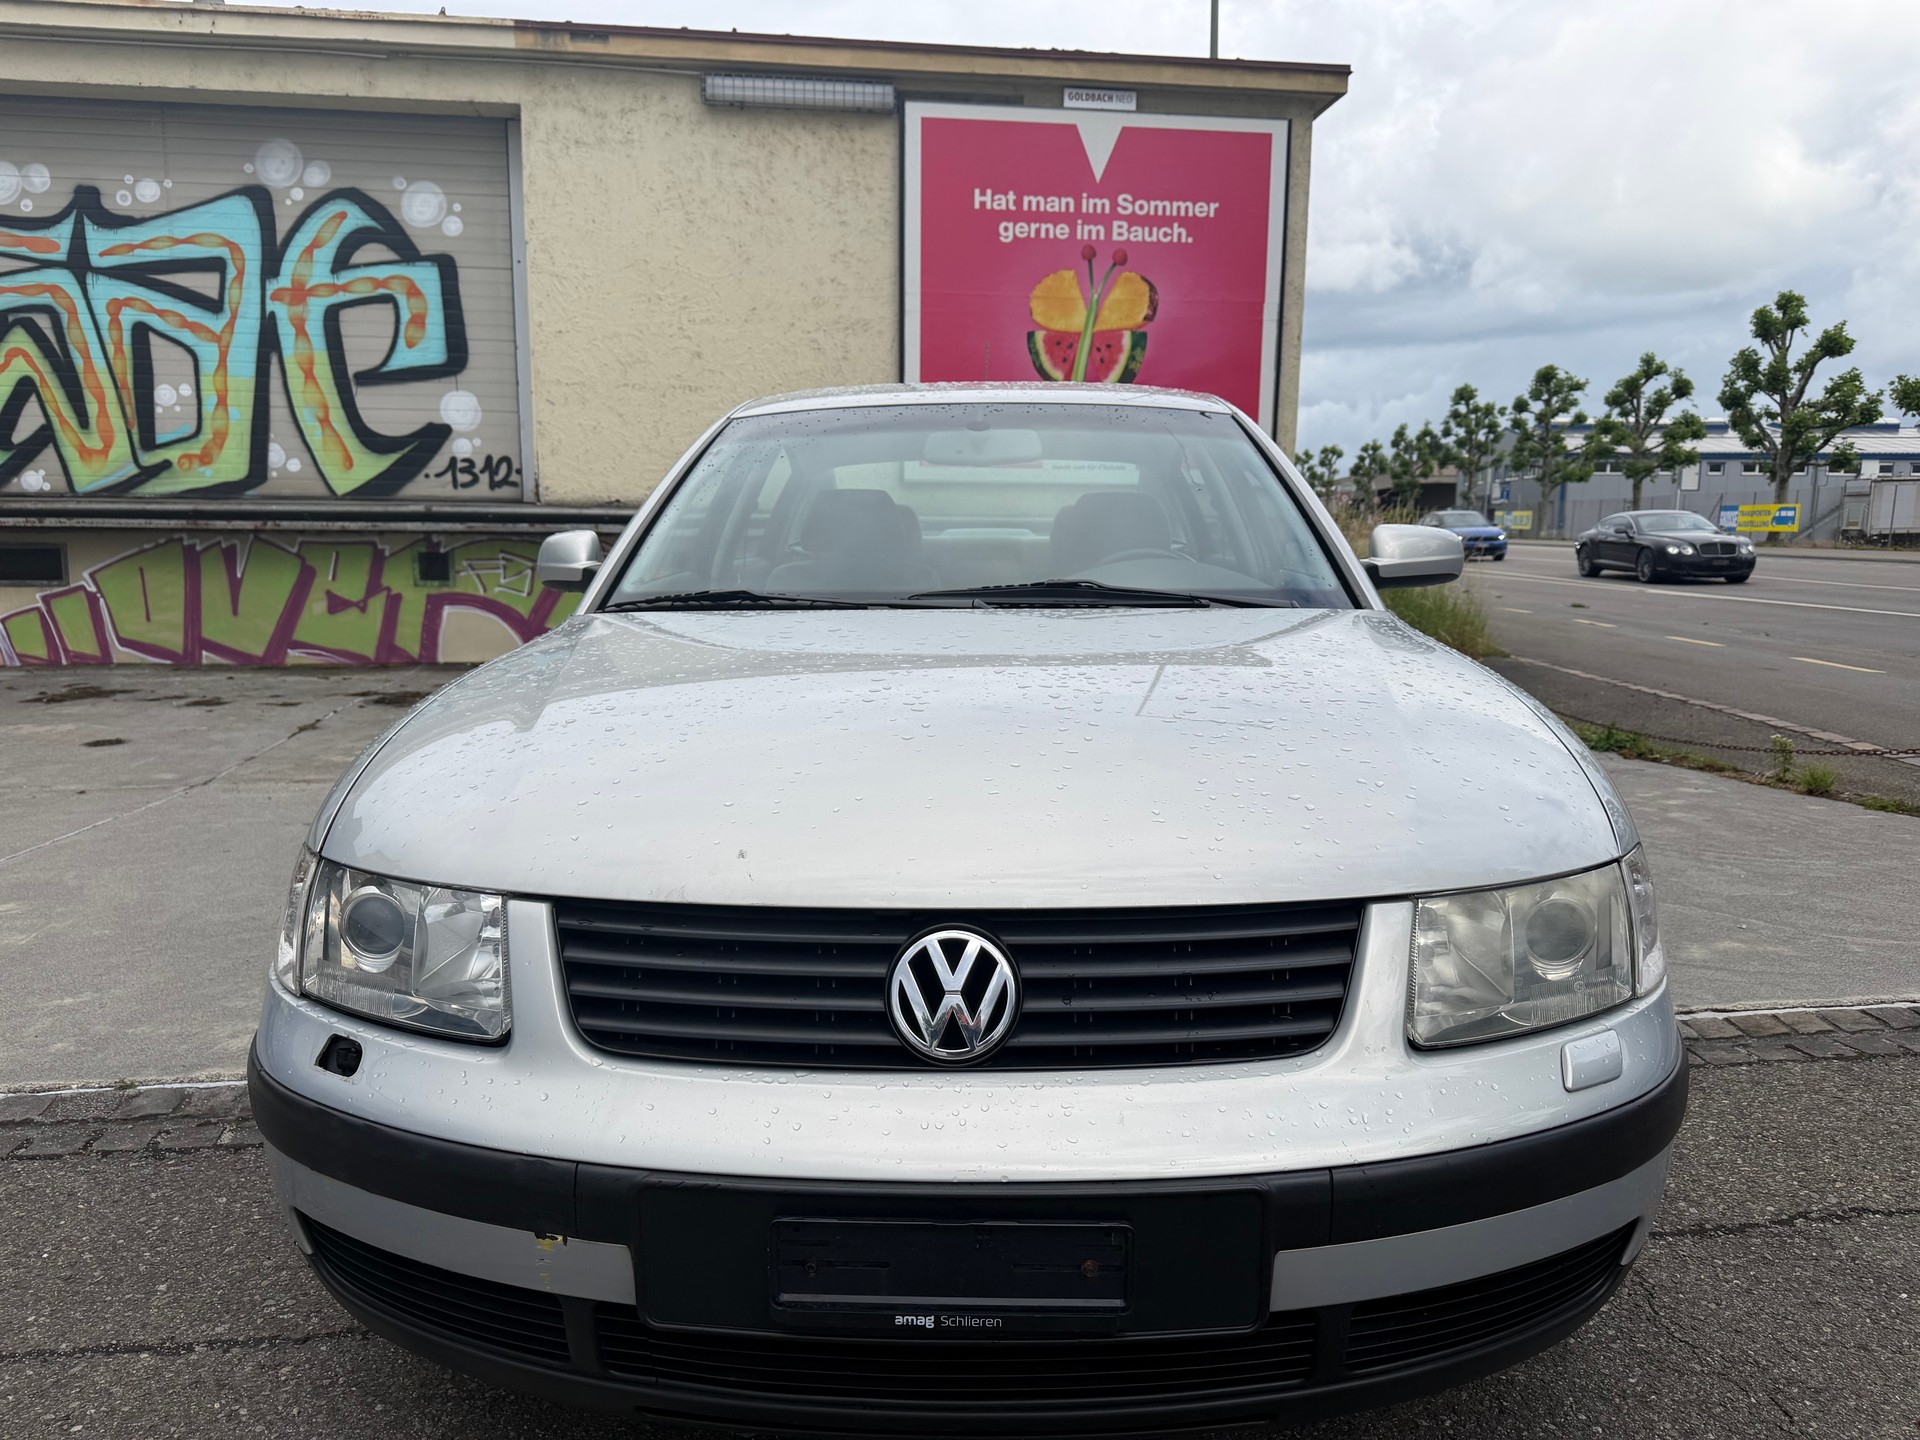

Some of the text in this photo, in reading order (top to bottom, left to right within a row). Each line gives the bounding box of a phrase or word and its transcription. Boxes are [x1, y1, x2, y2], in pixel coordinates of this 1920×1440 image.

[1068, 91, 1134, 104] GOLDBACH NEO
[973, 188, 1219, 218] Hat man im Sommer
[998, 219, 1193, 243] gerne im Bauch.
[891, 929, 1015, 1060] VW
[895, 1315, 1002, 1329] amag Schlieren
